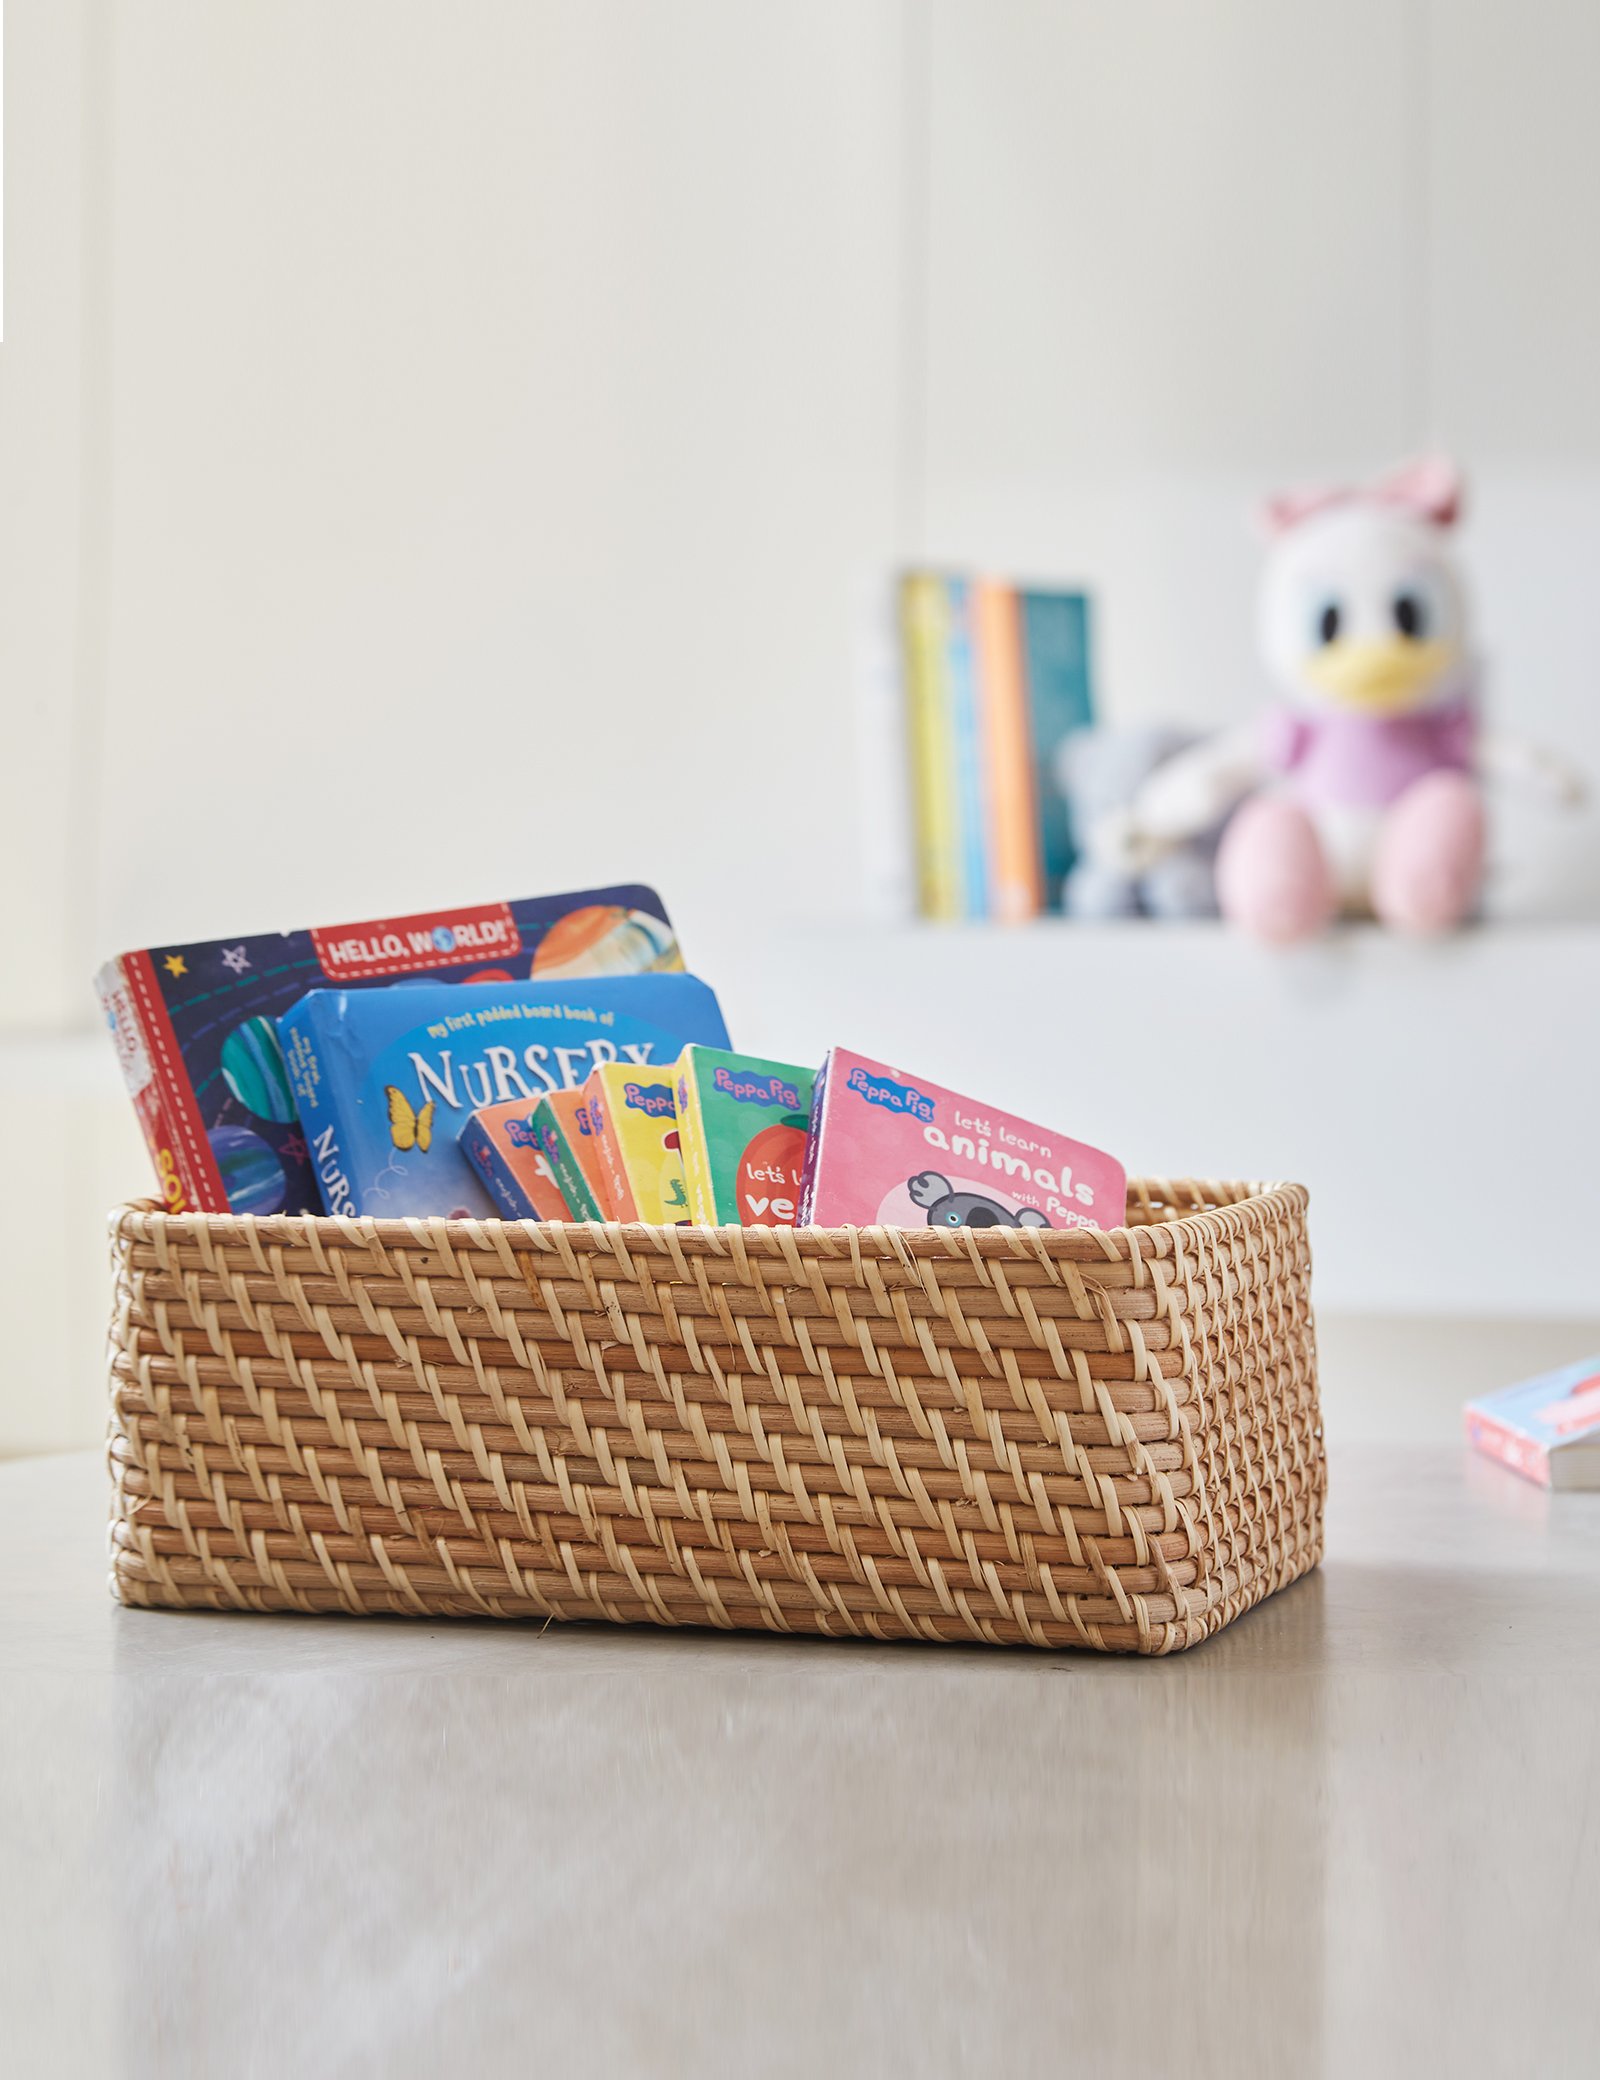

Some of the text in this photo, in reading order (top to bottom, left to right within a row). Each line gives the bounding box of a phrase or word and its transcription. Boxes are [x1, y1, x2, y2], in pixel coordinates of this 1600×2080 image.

[327, 934, 410, 965] HELLO,
[427, 1004, 614, 1039] my first padded board book of
[715, 1068, 770, 1099] Peppa
[770, 1079, 800, 1108] Pig
[851, 1069, 903, 1108] Peppa
[904, 1090, 934, 1121] Pig
[954, 1110, 1052, 1158] let's learn
[746, 1162, 786, 1184] let's
[923, 1126, 1095, 1206] animals
[1012, 1191, 1100, 1230] with Peppa
